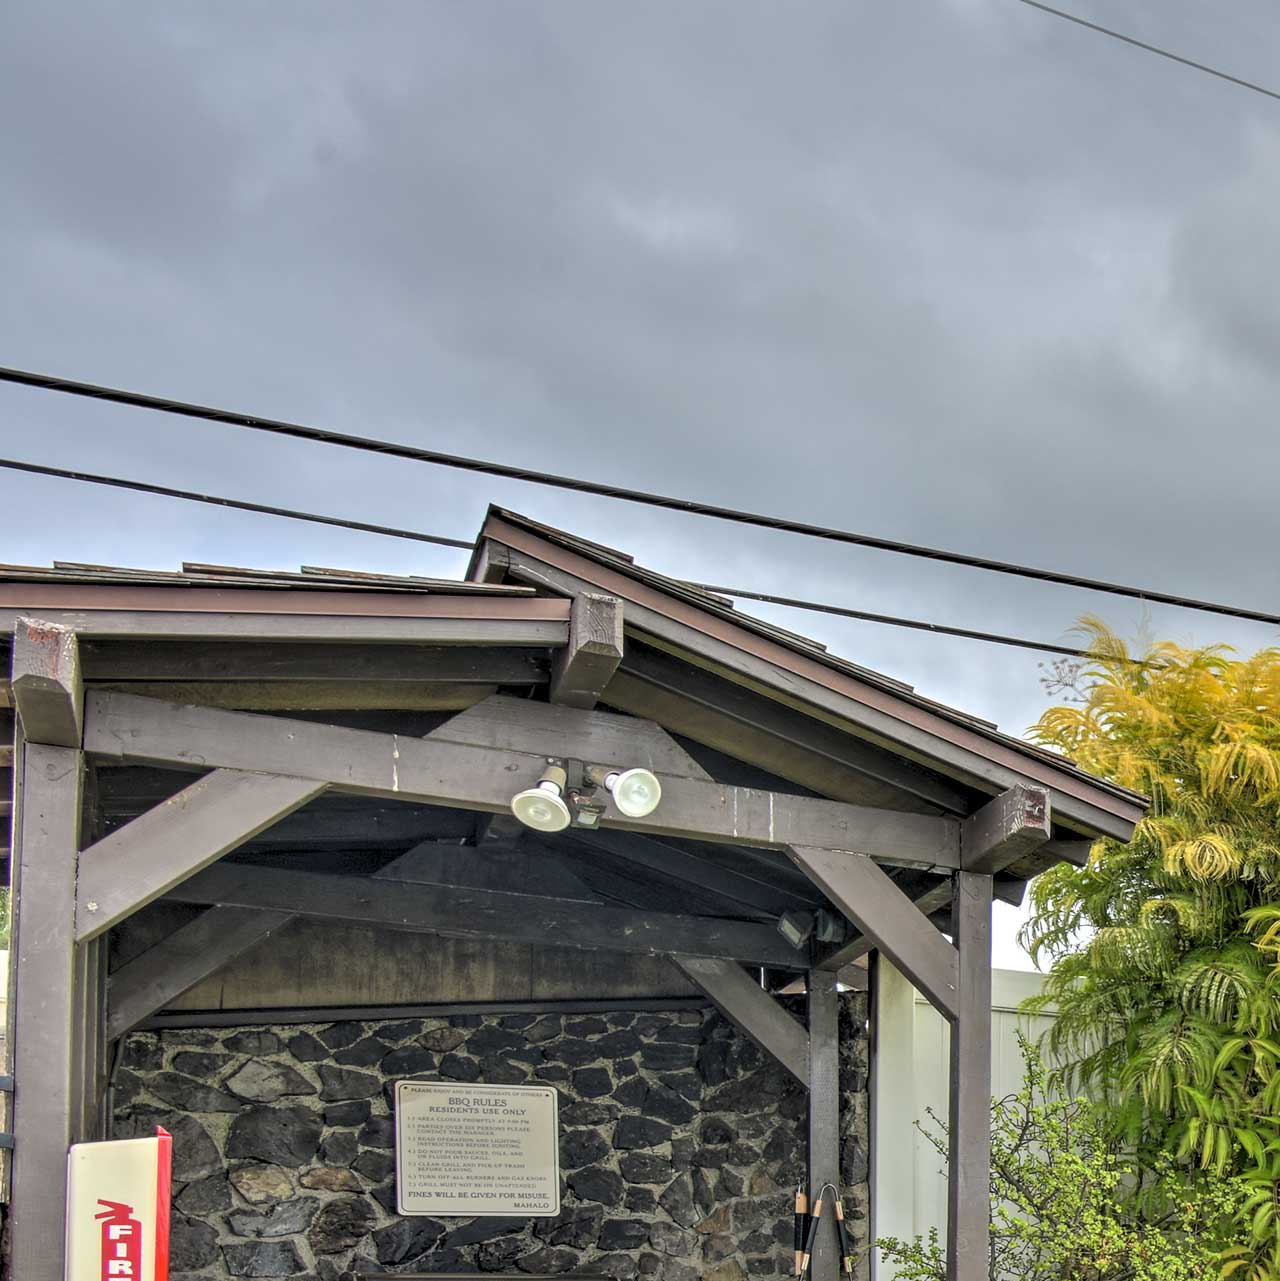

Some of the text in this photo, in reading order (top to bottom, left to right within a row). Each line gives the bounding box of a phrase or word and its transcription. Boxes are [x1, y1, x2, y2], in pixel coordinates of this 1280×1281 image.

[448, 1097, 507, 1107] BBQ RULES
[429, 1106, 479, 1114] RESIDENTS
[502, 1108, 527, 1116] ONLY
